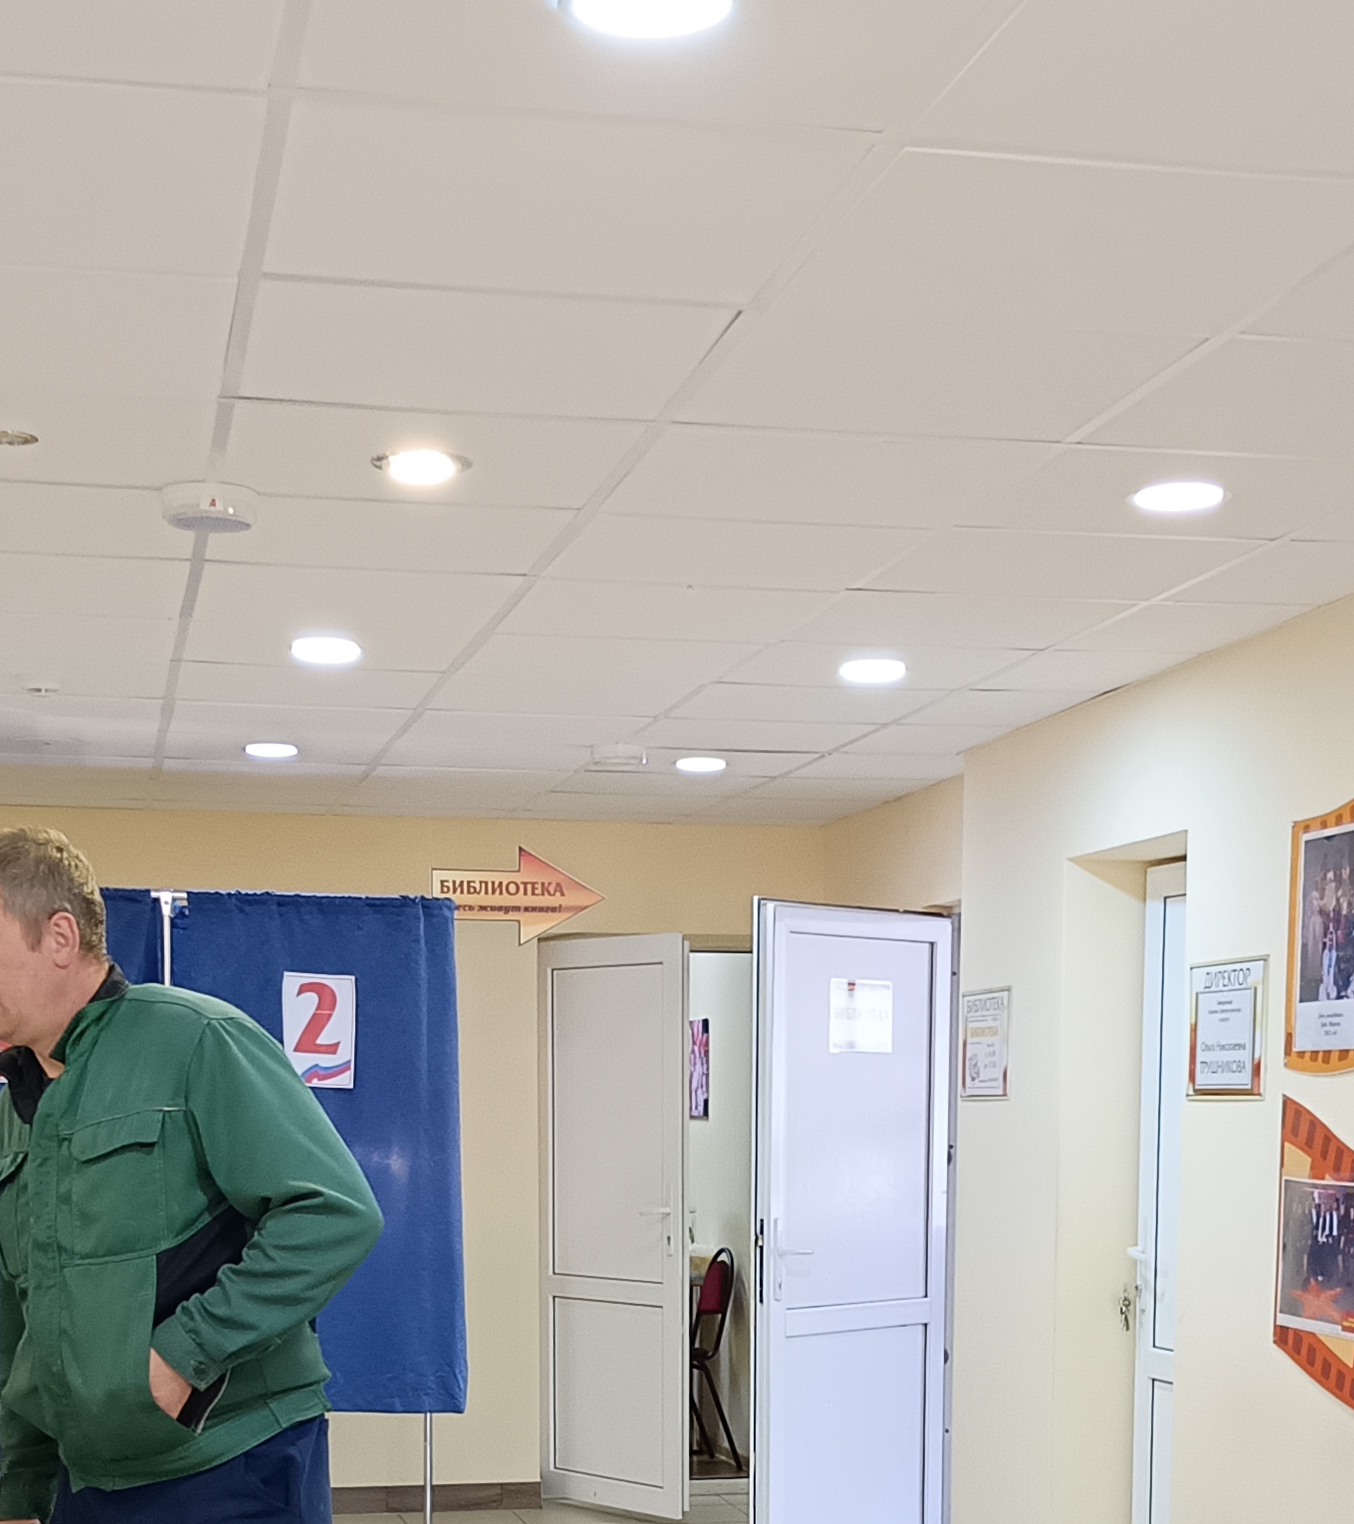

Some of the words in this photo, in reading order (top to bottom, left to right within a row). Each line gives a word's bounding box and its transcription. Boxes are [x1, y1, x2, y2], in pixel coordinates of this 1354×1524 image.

[439, 879, 565, 897] БИБЛИОТЕКА
[455, 904, 475, 912] есь
[477, 904, 522, 914] живут
[1204, 968, 1251, 989] ДИРЕКТОР
[292, 981, 342, 1056] 2
